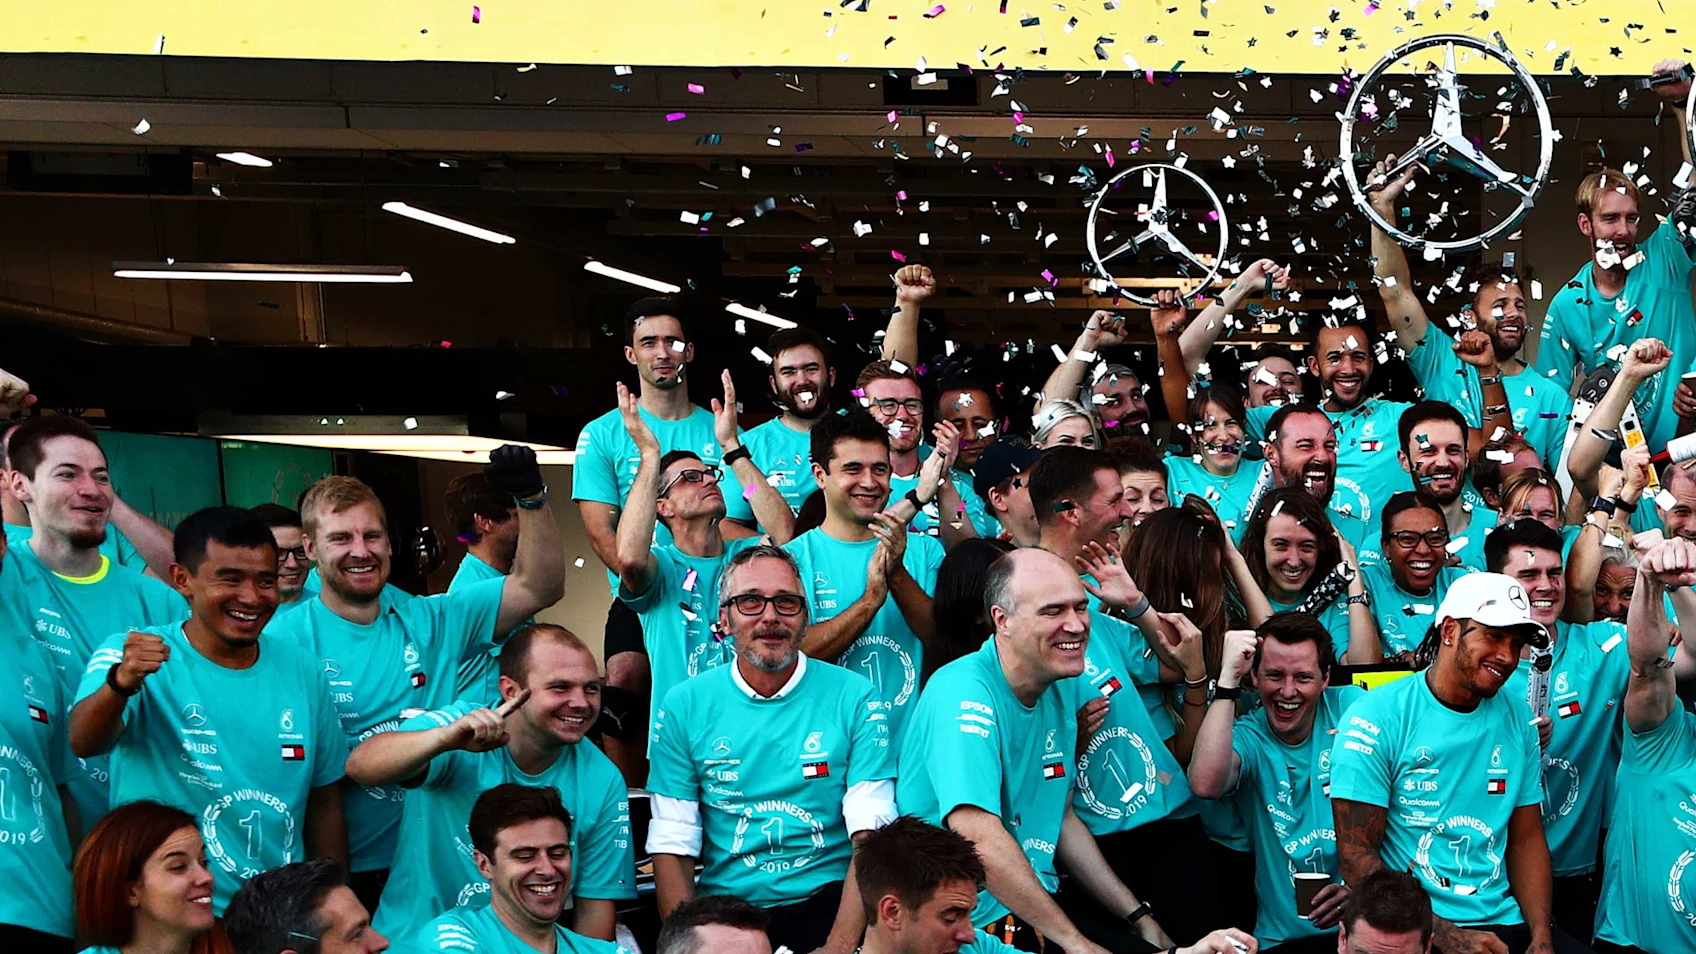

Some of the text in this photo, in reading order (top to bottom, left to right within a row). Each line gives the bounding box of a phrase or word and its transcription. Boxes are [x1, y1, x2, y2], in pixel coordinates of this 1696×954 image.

[1335, 476, 1362, 494] NNERS
[818, 599, 837, 609] UBS
[48, 625, 71, 639] UBS
[855, 635, 901, 653] WINNERS
[960, 700, 994, 717] EPSON
[1349, 715, 1381, 737] EPSON
[192, 742, 218, 755] UBS
[1078, 727, 1130, 771] GP WINNERS
[90, 767, 108, 783] 20
[717, 771, 739, 781] UBS
[708, 784, 744, 797] Qualcomm
[1416, 779, 1438, 792] UBS
[234, 789, 288, 814] WINNERS
[1125, 794, 1149, 817] 2019
[1399, 795, 1441, 807] Qualcomm
[754, 800, 812, 823] WINNERS
[1446, 815, 1494, 838] WINNERS
[0, 830, 26, 845] 019
[1284, 841, 1300, 855] GP
[759, 861, 791, 873] 2019
